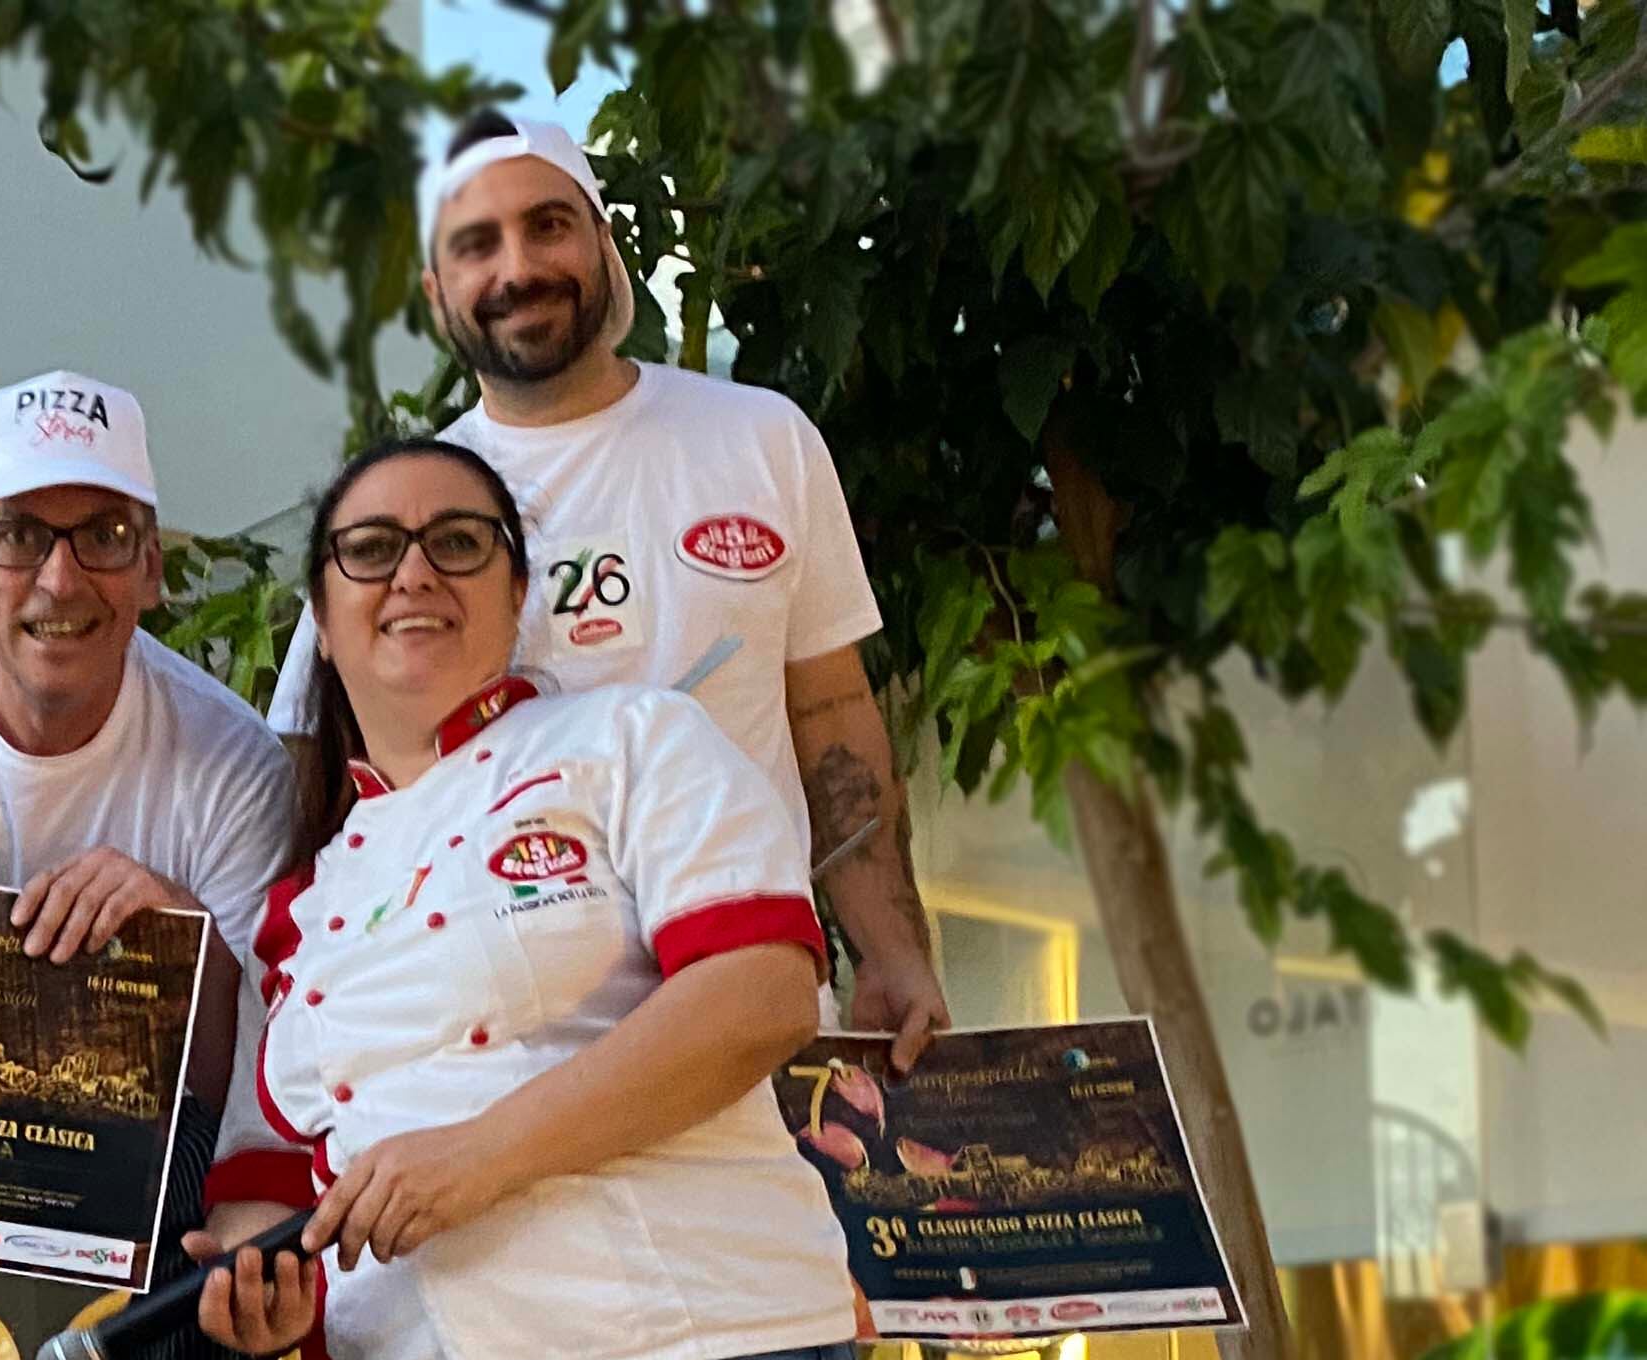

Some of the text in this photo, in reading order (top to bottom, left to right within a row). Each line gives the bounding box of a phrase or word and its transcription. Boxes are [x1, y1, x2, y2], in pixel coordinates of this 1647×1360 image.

[15, 389, 110, 431] PIZZA
[547, 552, 631, 616] 26
[917, 1216, 1022, 1238] CLASIFICADO
[1025, 1212, 1075, 1232] PIZZA
